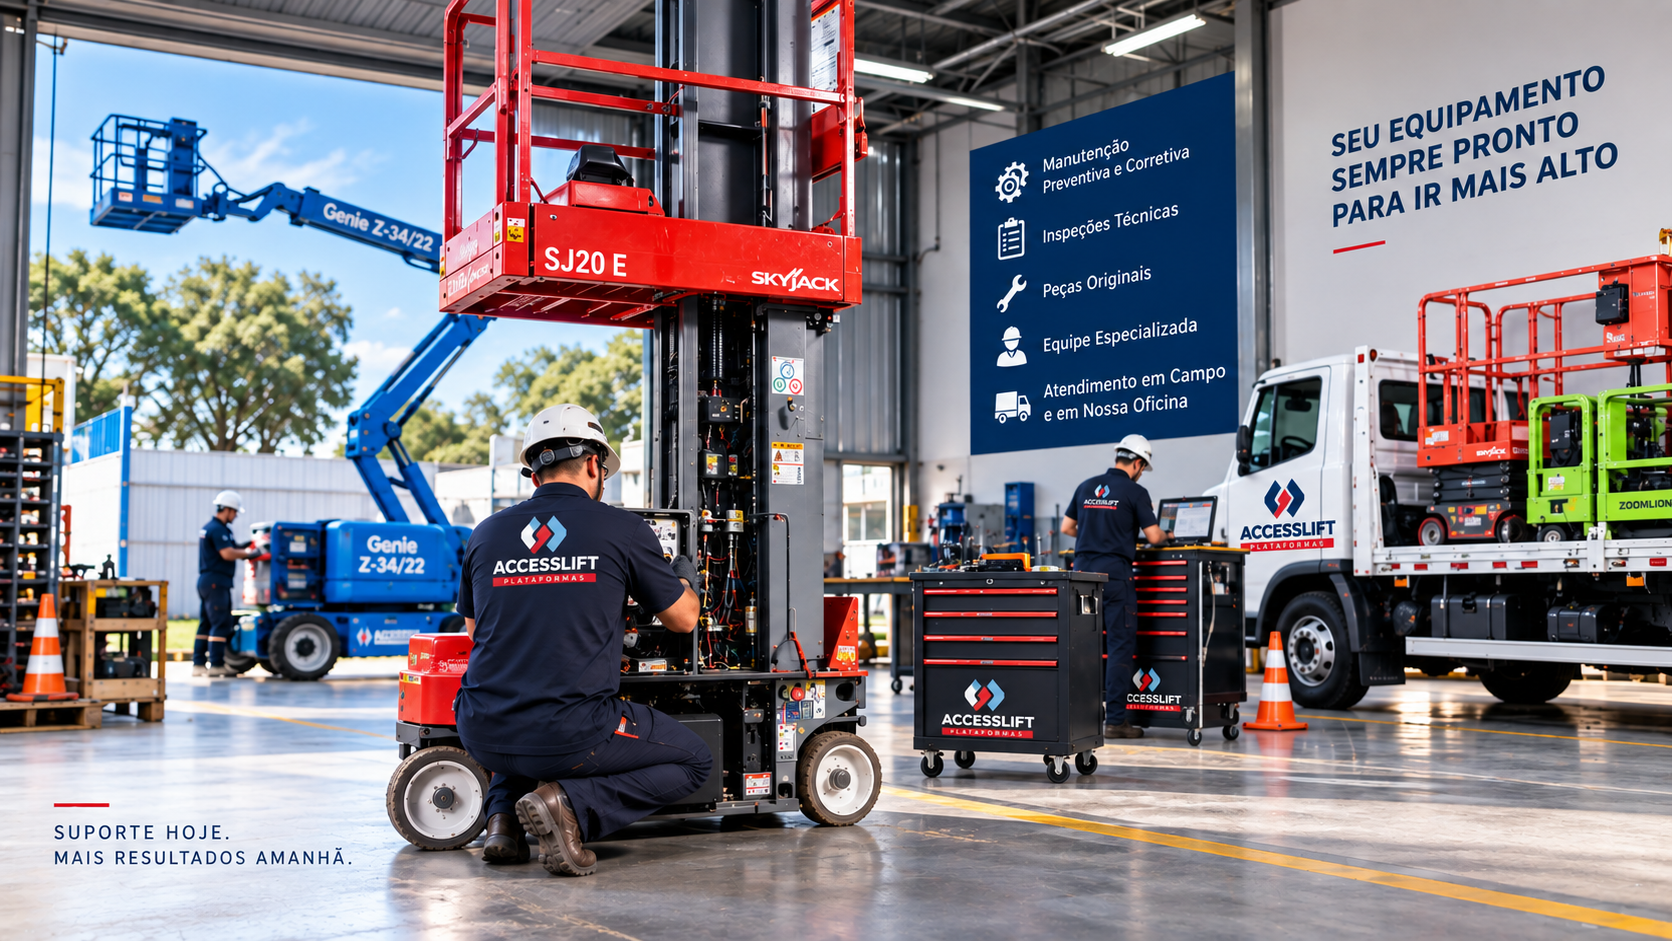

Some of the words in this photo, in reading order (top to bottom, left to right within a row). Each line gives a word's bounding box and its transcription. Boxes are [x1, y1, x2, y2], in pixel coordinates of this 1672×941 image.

[1331, 123, 1380, 157] SEU
[1389, 65, 1606, 143] EQUIPAMENTO
[1043, 138, 1130, 173] Manutenção
[1331, 143, 1443, 192] SEMPRE
[1453, 111, 1579, 164] PRONTO
[1043, 164, 1110, 194] Preventiva
[1114, 163, 1122, 175] e
[1126, 147, 1190, 173] Corretiva
[1333, 190, 1405, 228] PARA
[1414, 181, 1442, 210] IR
[1452, 162, 1527, 202] MAIS
[1536, 142, 1618, 184] ALTO
[323, 202, 369, 232] Genie
[371, 219, 434, 253] Z-34/22
[1043, 218, 1111, 244] Inspeções
[1113, 204, 1179, 228] Técnicas
[544, 246, 605, 275] SJ20
[613, 252, 627, 277] E
[751, 267, 840, 292] SKYJACK
[1043, 280, 1083, 299] Peças
[1087, 265, 1152, 290] Originais
[1043, 334, 1091, 353] Equipe
[1095, 317, 1198, 341] Especializada
[1043, 376, 1138, 398] Atendimento
[1141, 370, 1166, 387] em
[1170, 366, 1226, 384] Campo
[1044, 409, 1052, 422] e
[1056, 407, 1079, 421] em
[1083, 401, 1128, 418] Nossa
[1133, 394, 1188, 414] Oficina
[1619, 499, 1672, 510] ZOOMLION
[366, 534, 418, 554] Genie
[1240, 520, 1336, 540] ACCESSLIFT
[1250, 541, 1325, 550] PLATAFORMAS
[358, 555, 425, 575] Z-34/22
[493, 555, 599, 575] ACCESSLIFT
[503, 574, 585, 585] PLATAFORMAS
[1126, 693, 1182, 705] CCESSLIFT
[941, 713, 1035, 728] ACCESSLIFT
